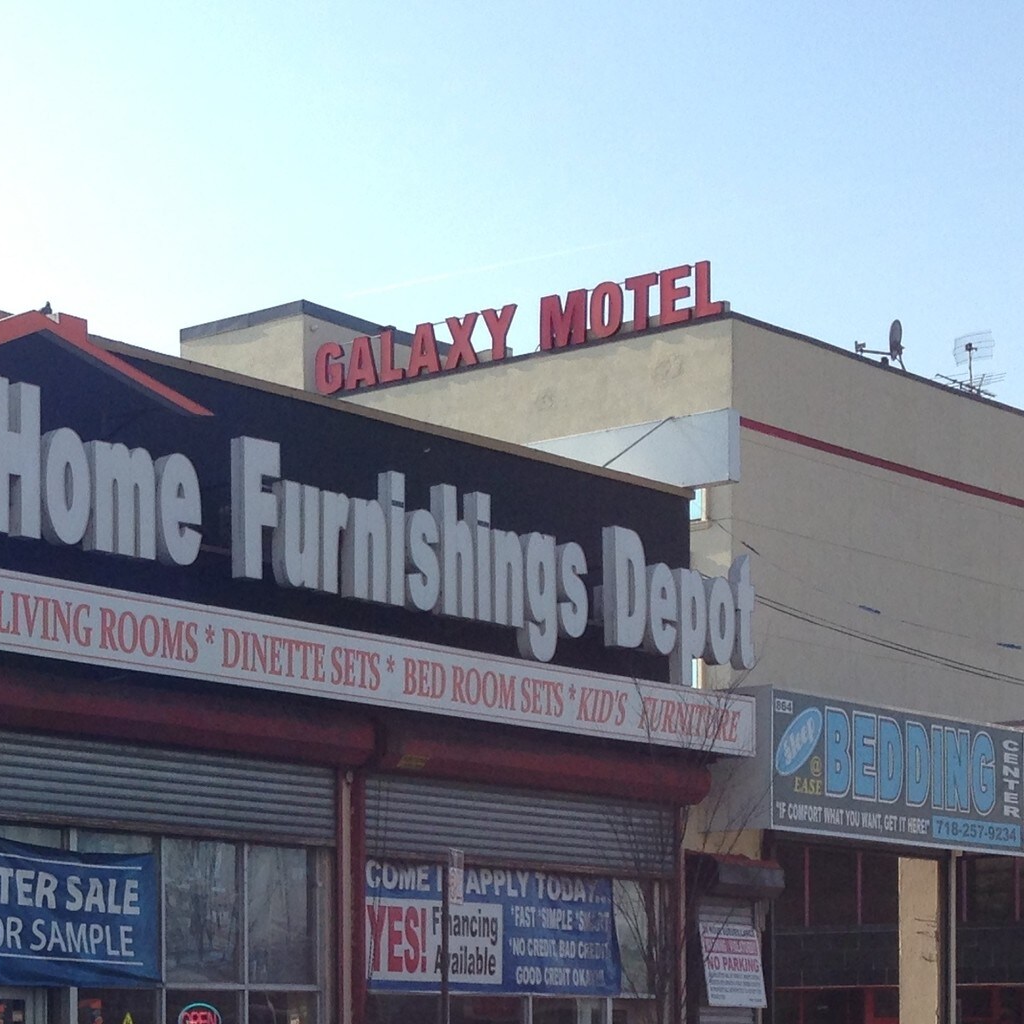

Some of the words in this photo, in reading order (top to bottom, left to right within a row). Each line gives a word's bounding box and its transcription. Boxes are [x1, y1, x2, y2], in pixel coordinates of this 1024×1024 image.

[314, 304, 518, 396] GALAXY
[539, 260, 726, 352] MOTEL
[231, 436, 589, 663] Furnishings
[602, 525, 756, 688] Depot
[99, 607, 199, 664] ROOMS
[221, 627, 326, 683] DINETTE
[330, 645, 381, 692] SETS
[403, 656, 447, 699] BED
[451, 665, 517, 711] ROOM
[521, 676, 565, 718] SETS
[576, 687, 628, 726] KID'S
[636, 695, 741, 743] FURNITURE
[825, 705, 996, 817] BEDDING
[1002, 739, 1020, 819] CENTER
[794, 776, 823, 796] EASE
[787, 802, 823, 822] COMFORT
[823, 808, 844, 825] WHAT
[845, 810, 860, 827] YOU
[884, 815, 898, 832] GET
[899, 816, 907, 832] IT
[936, 819, 1017, 842] 718-257-9234
[65, 876, 141, 916] SALE
[366, 859, 430, 892] COME
[466, 867, 530, 898] APPLY
[29, 918, 135, 957] SAMPLE
[366, 904, 427, 974] YES!
[432, 906, 498, 946] Fnancing
[433, 944, 497, 976] Aailable
[559, 940, 576, 959] BAD
[707, 956, 720, 971] NO
[722, 957, 760, 973] PARKING
[515, 965, 542, 986] GOOD
[543, 967, 570, 987] CREDIT
